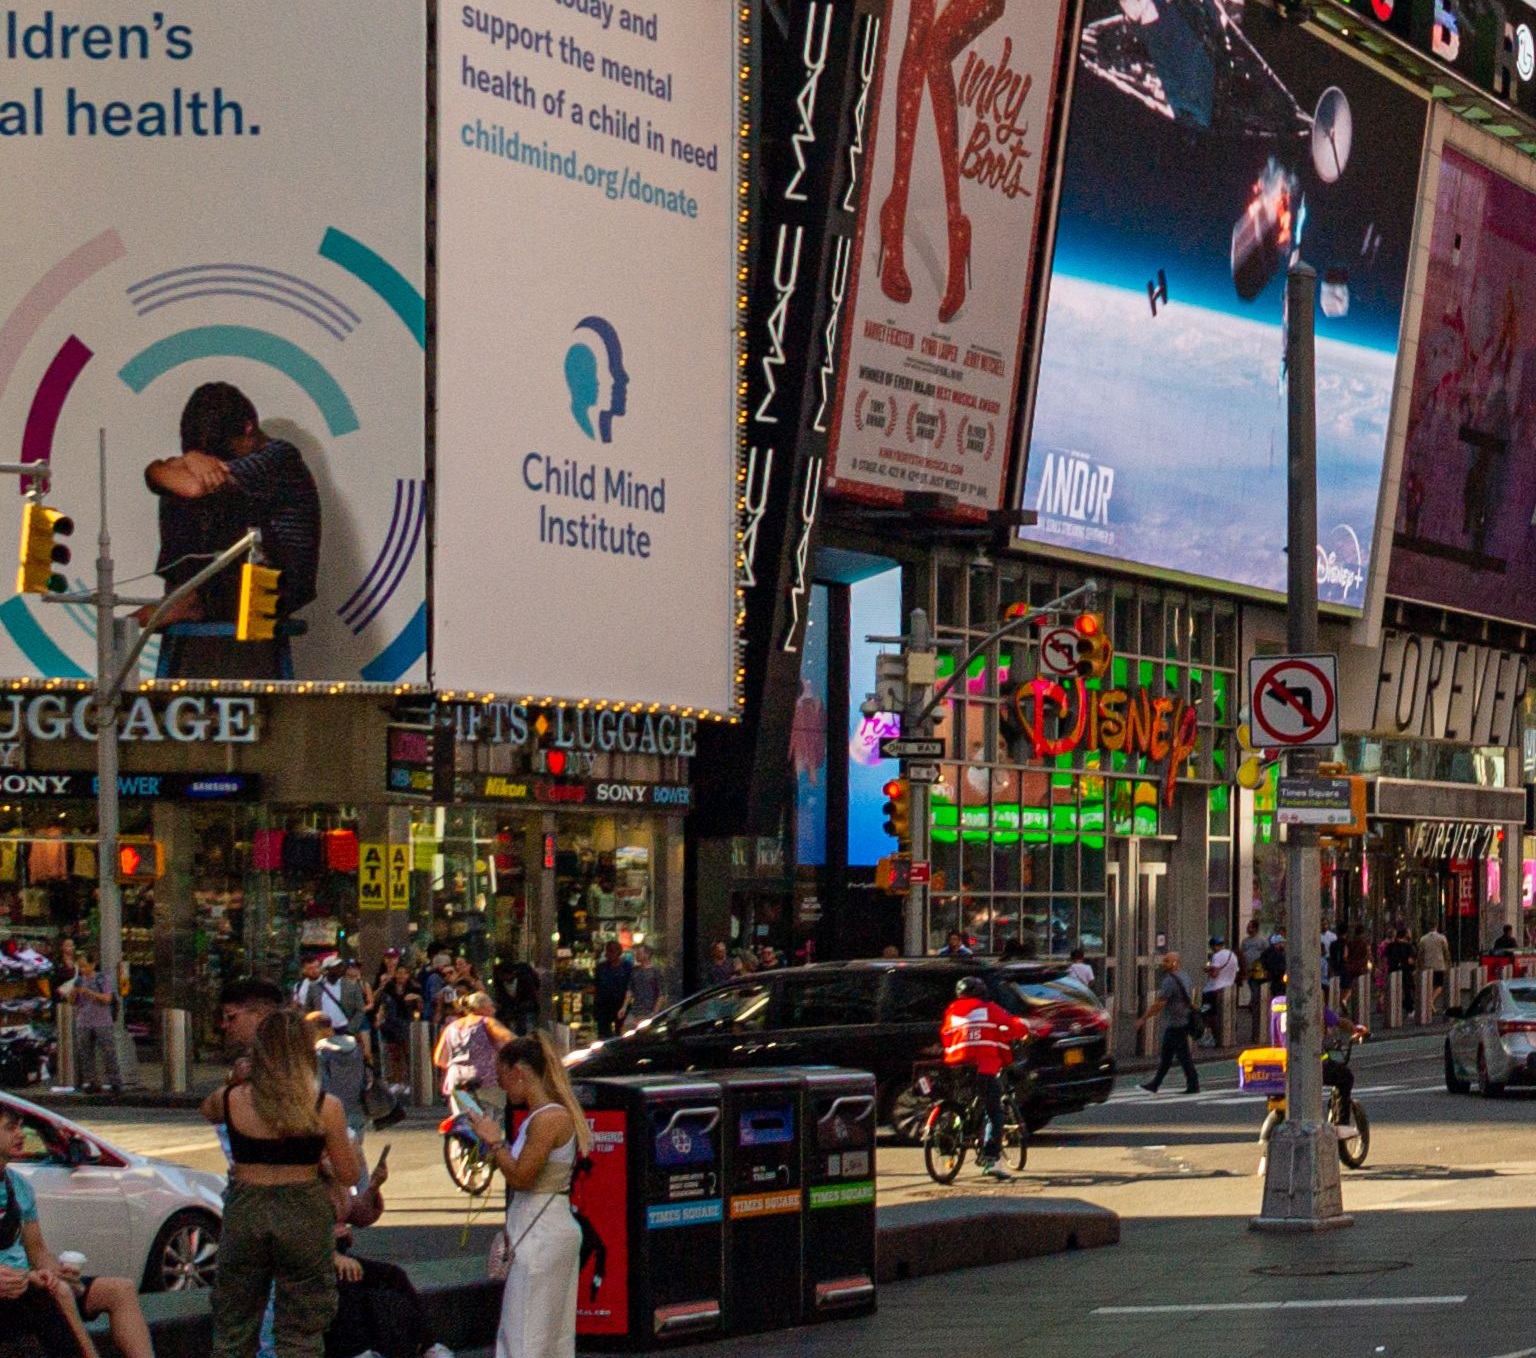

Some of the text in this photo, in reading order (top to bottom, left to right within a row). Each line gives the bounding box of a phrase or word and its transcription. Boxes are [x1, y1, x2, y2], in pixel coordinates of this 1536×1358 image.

[619, 14, 658, 41] and
[462, 5, 672, 101] support the mental
[0, 88, 262, 136] al health.
[462, 55, 718, 171] health of a child in need
[461, 119, 699, 218] childmind.org/donate
[522, 452, 666, 514] Child Mind
[539, 504, 651, 558] Institute
[1373, 628, 1527, 747] FOREVER
[555, 708, 697, 756] LUGGAGE
[93, 777, 160, 795] BWER
[485, 776, 526, 798] Nikon
[597, 784, 646, 801] SONY
[1281, 787, 1340, 799] Times Square
[1413, 822, 1476, 859] FOREVER
